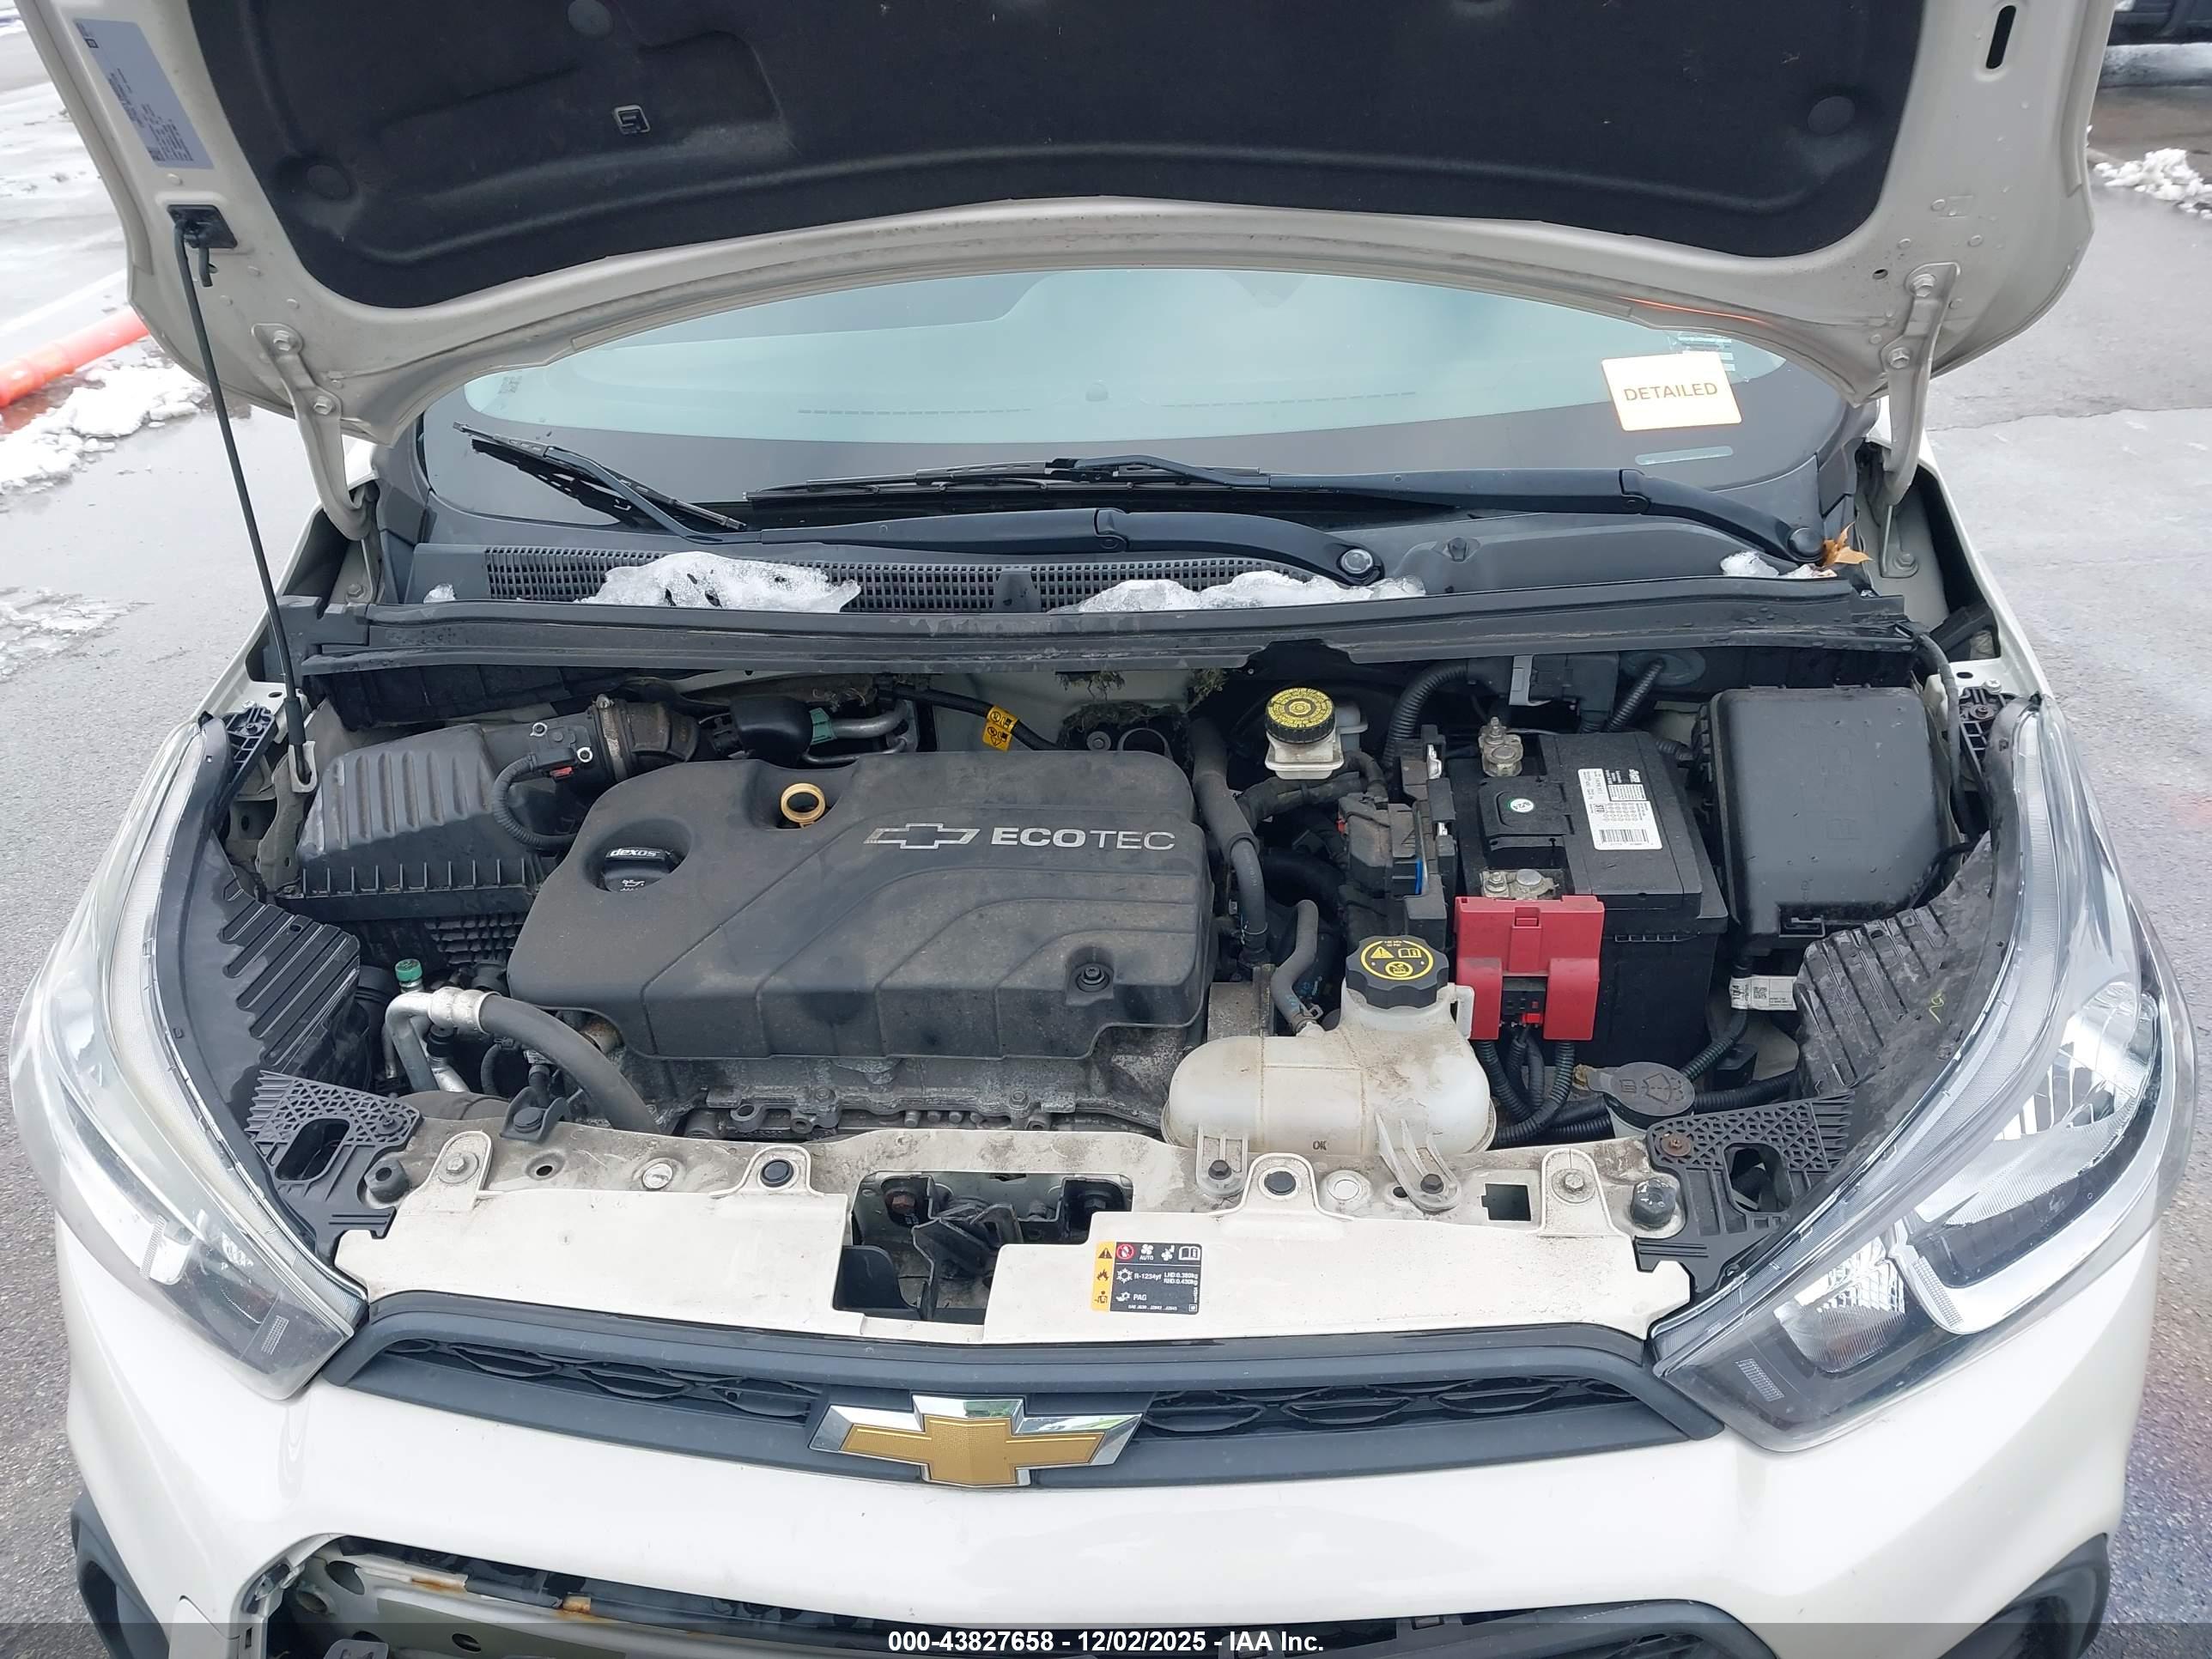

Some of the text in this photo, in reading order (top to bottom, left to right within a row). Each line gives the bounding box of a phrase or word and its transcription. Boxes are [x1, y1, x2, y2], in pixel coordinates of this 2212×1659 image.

[1624, 382, 1717, 401] DETAILED
[991, 827, 1176, 851] ECOTEC
[610, 848, 657, 857] dexos
[1312, 1139, 1328, 1151] OK
